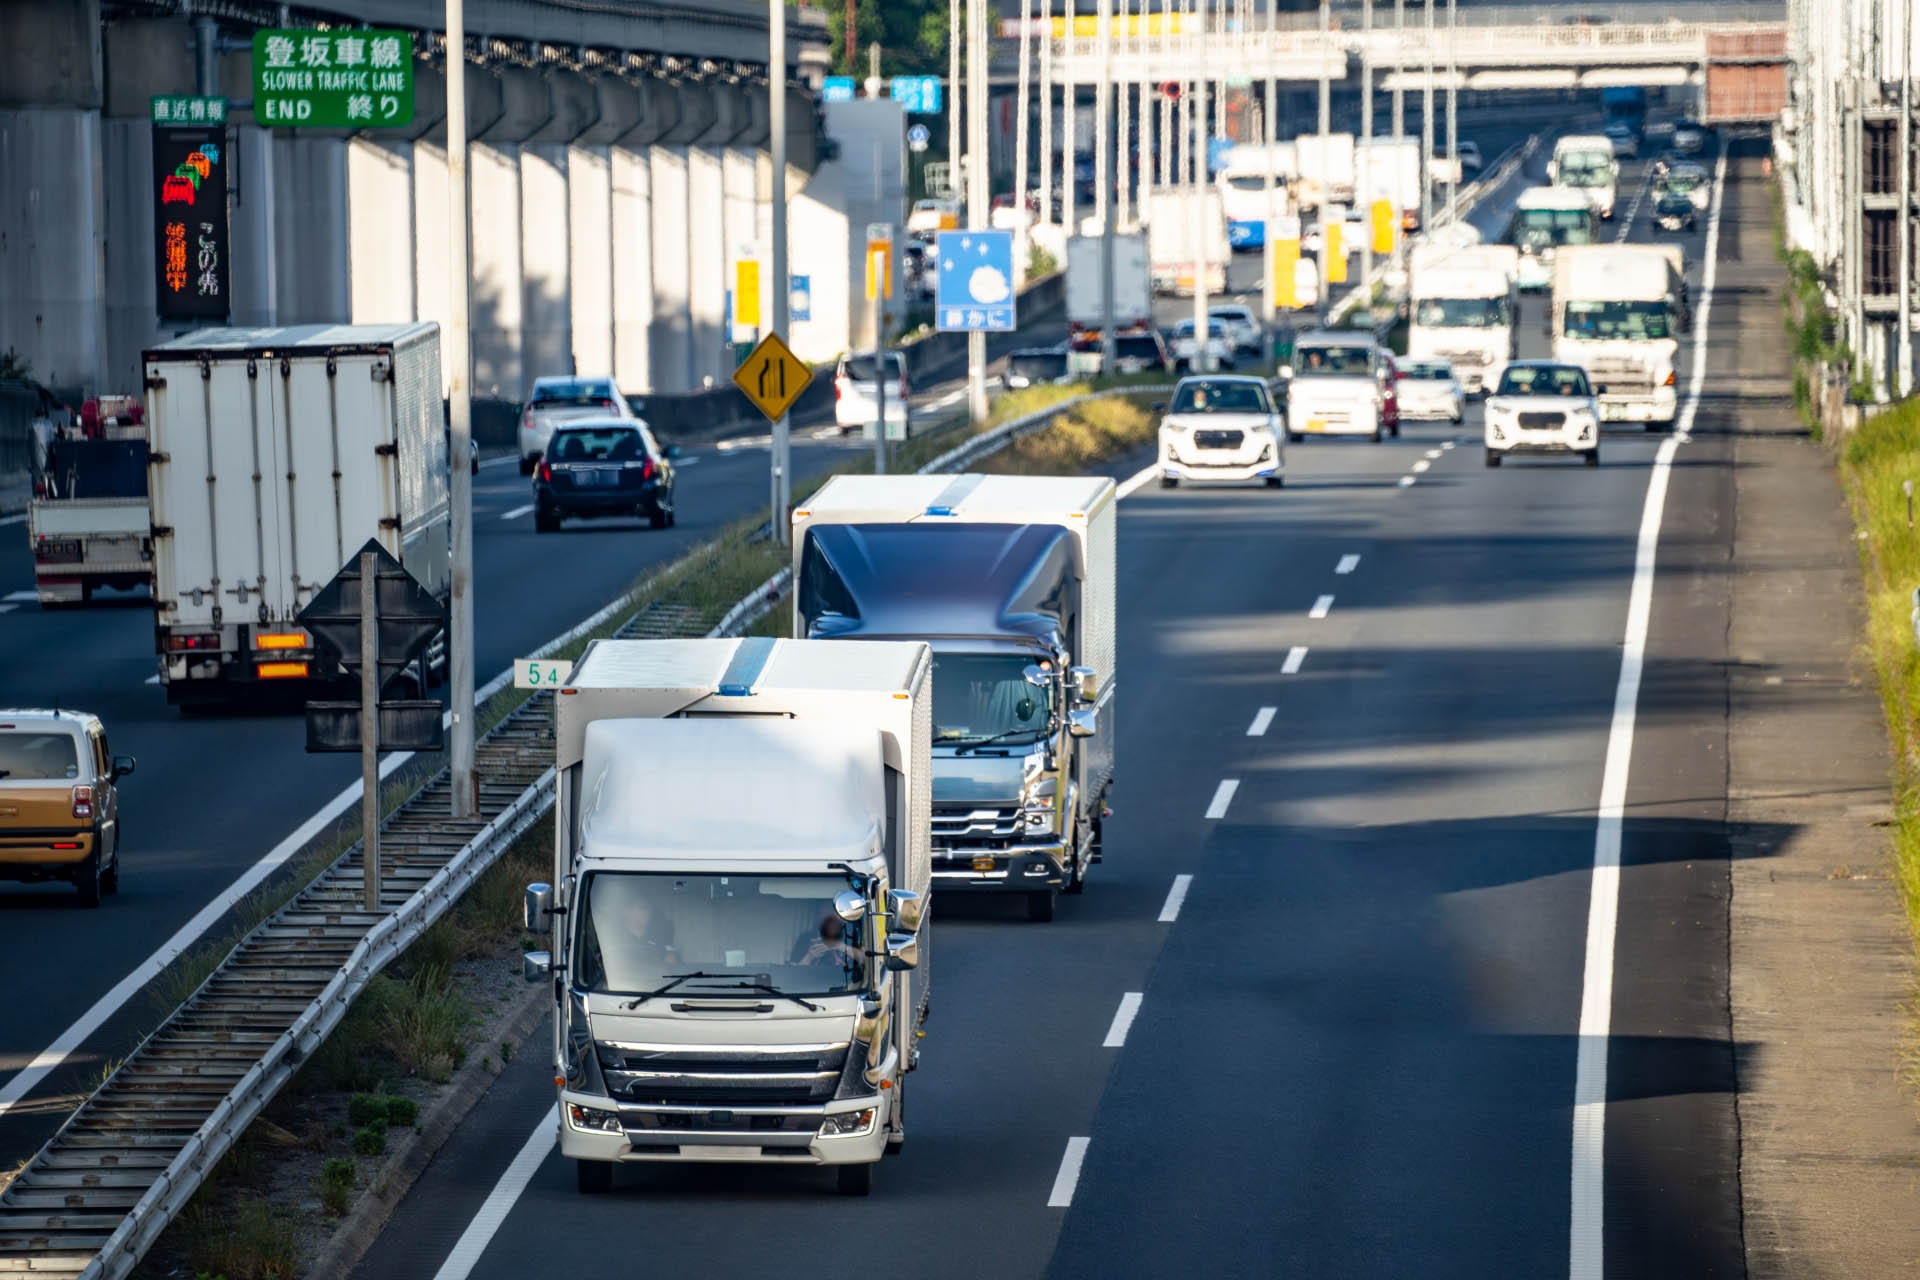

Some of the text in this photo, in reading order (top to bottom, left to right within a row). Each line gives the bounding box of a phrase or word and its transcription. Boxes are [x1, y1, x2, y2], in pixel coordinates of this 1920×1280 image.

[265, 35, 401, 68] 登坂車線
[262, 70, 405, 92] SLOWER TRAFFIC LANE
[154, 100, 225, 121] 直近情報
[265, 100, 312, 120] END
[347, 95, 399, 120] 終り
